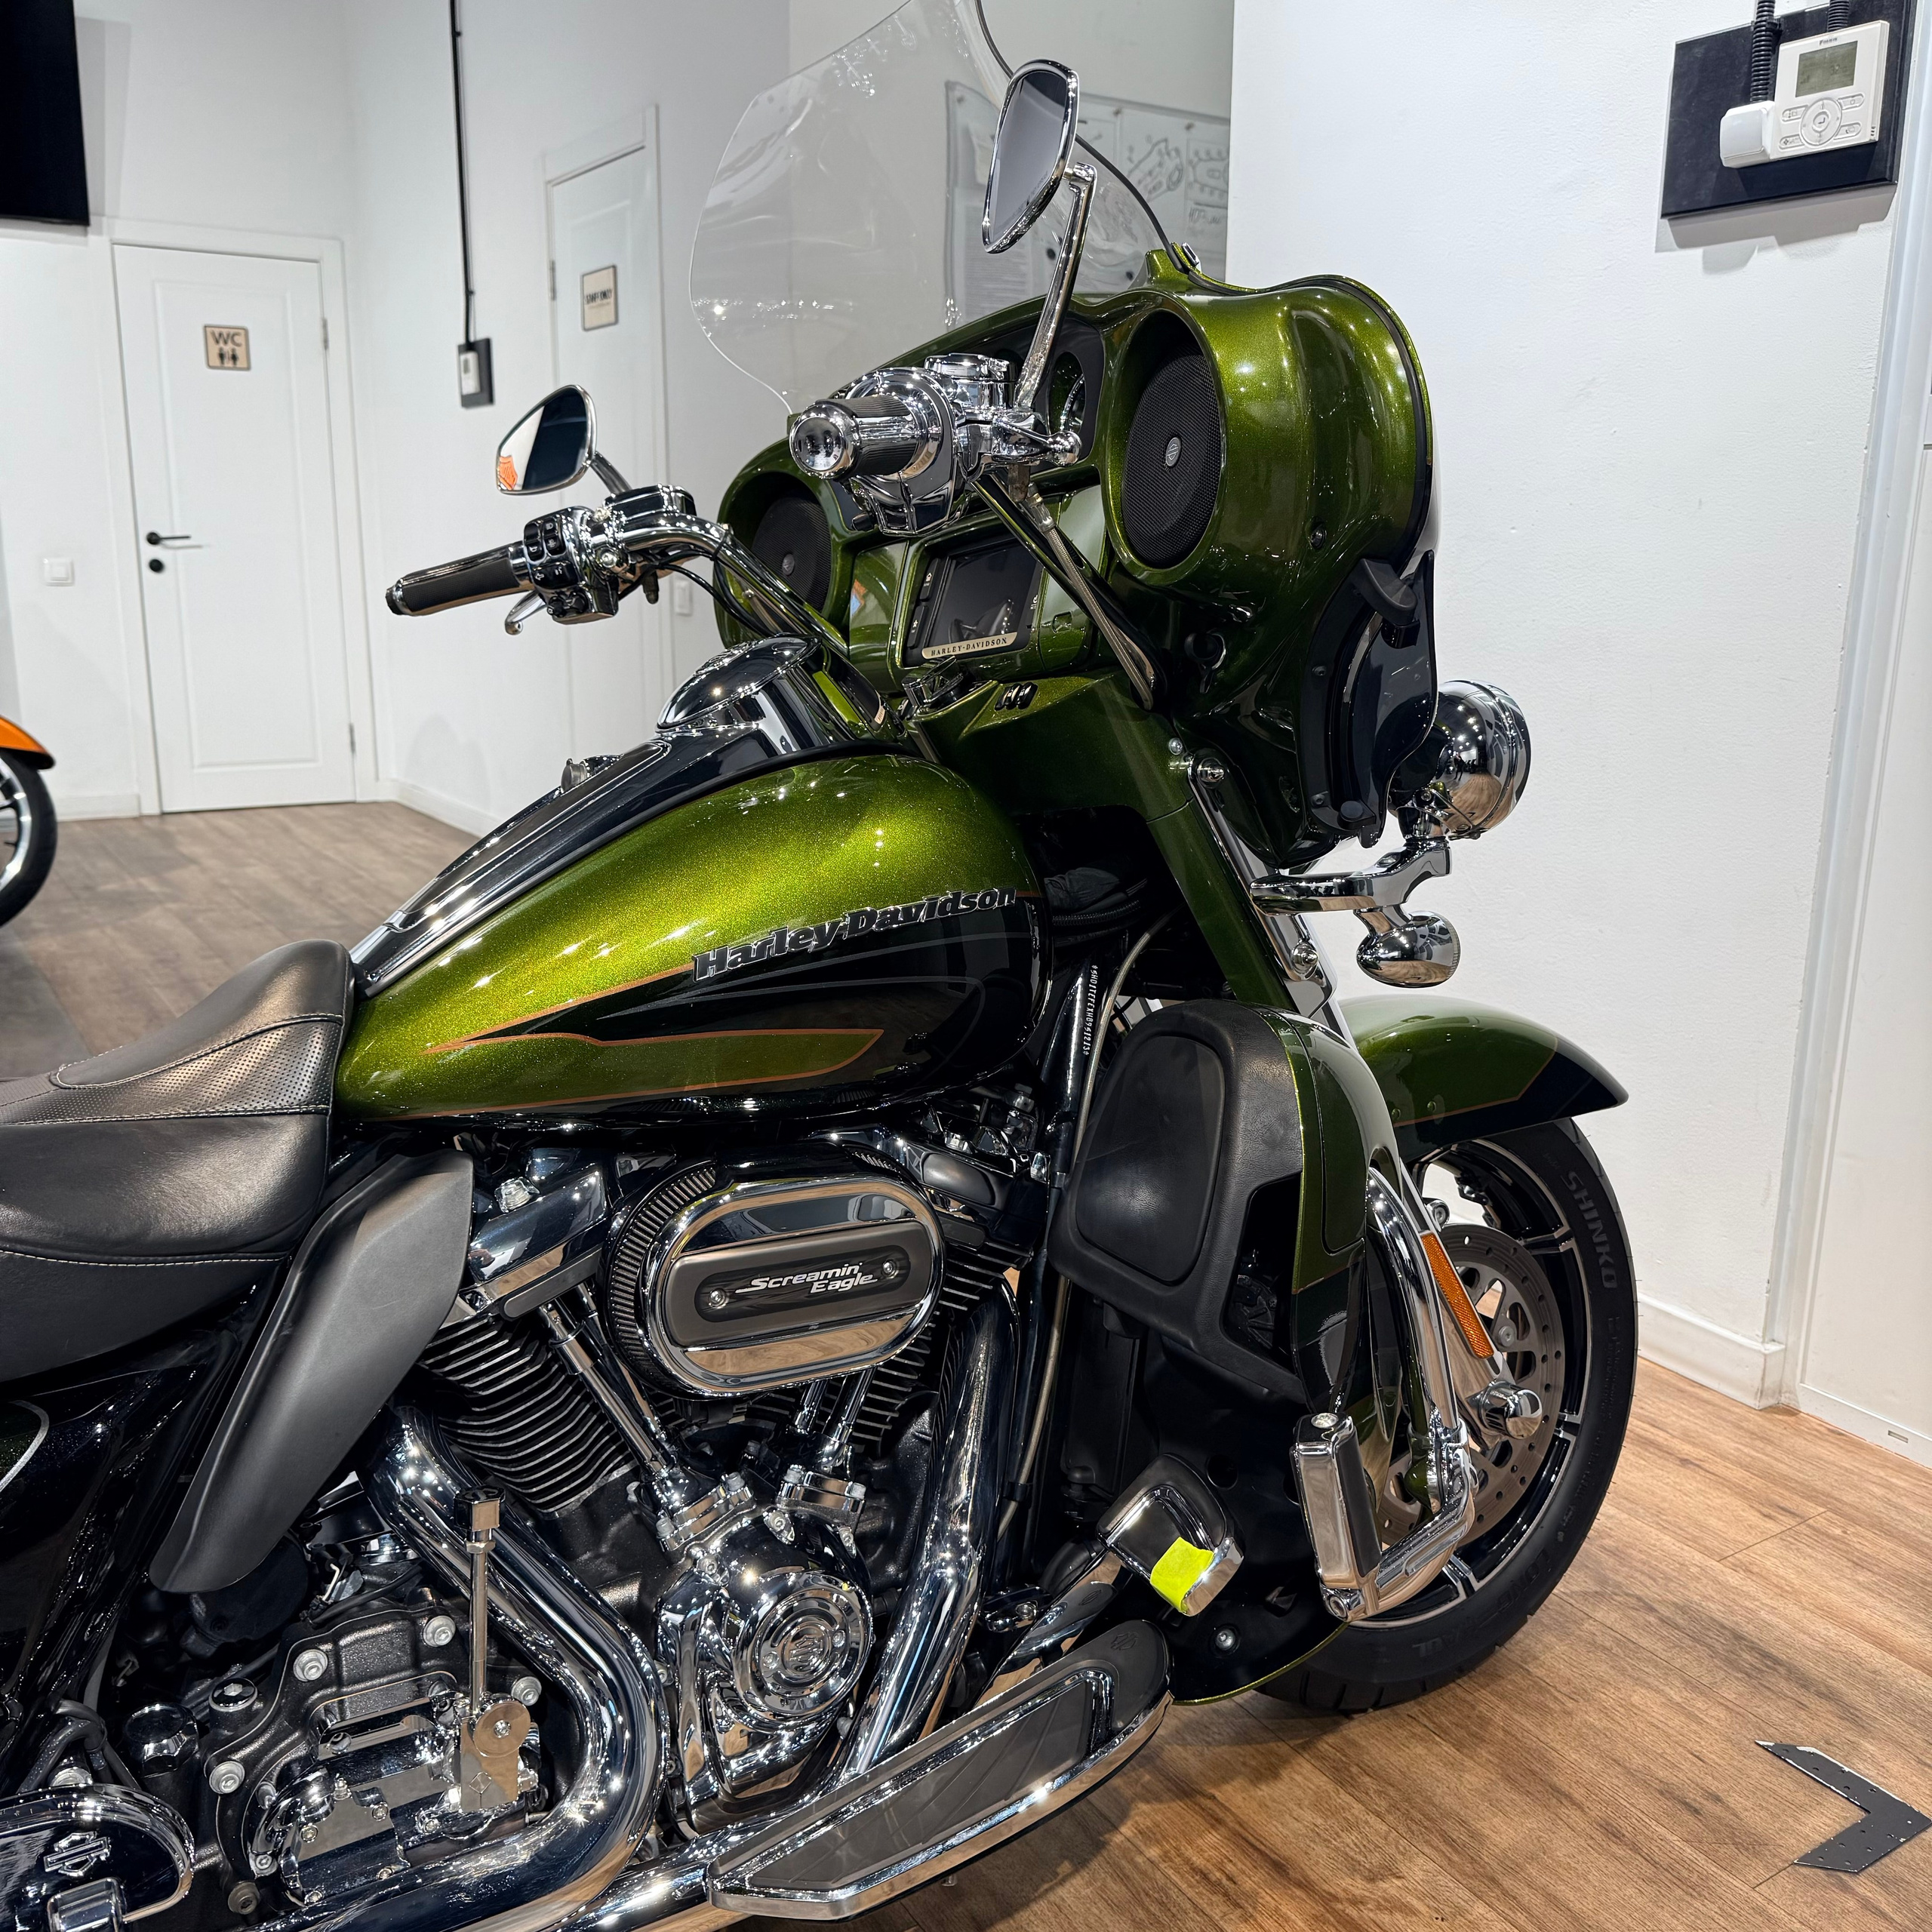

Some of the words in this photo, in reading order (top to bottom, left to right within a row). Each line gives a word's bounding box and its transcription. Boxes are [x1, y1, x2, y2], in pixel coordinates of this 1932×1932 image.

[210, 330, 242, 347] WC
[931, 637, 1008, 657] HARLEY-DAVIDSON
[1560, 1171, 1618, 1289] SHINKO
[735, 1262, 863, 1294] Screamin'
[810, 1272, 878, 1294] Eagle
